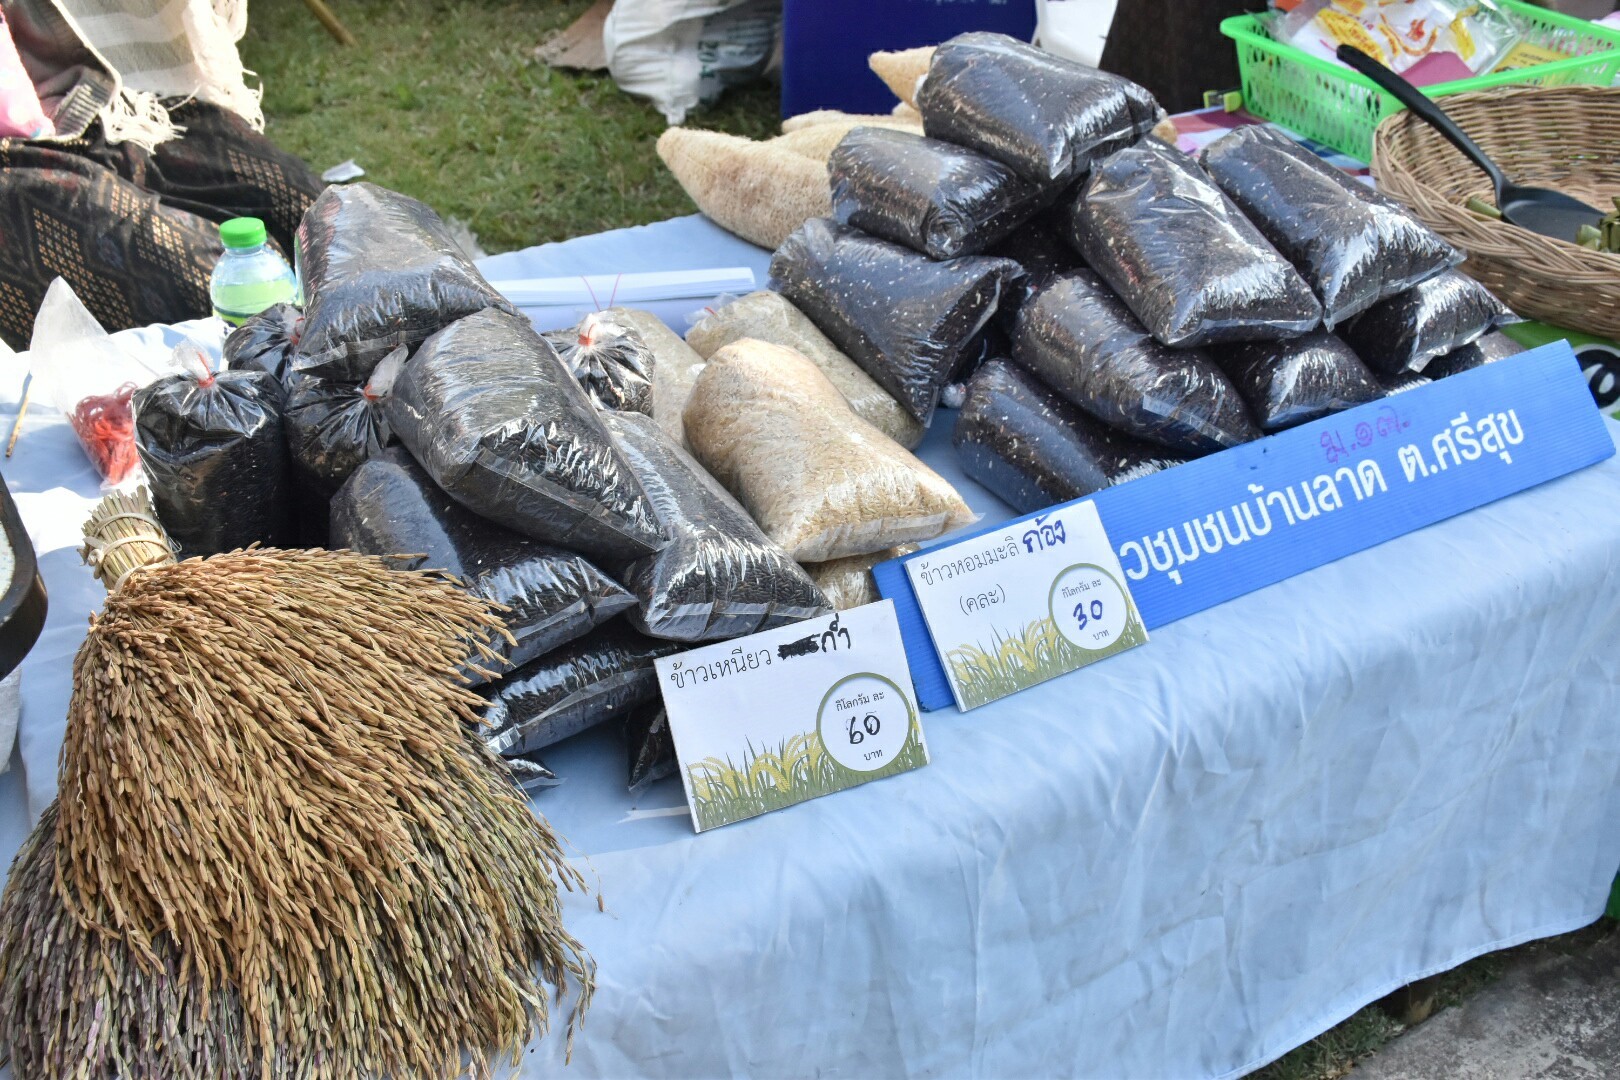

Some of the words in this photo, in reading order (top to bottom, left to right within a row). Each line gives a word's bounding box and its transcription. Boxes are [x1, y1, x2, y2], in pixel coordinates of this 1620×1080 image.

[1397, 408, 1524, 483] ต.ศรีสุข
[920, 535, 1020, 586] ข้าวหอมมะลิ
[959, 583, 1006, 617] (คละ)
[1072, 599, 1103, 631] 30
[1093, 629, 1110, 641] บาท
[670, 645, 772, 689] ข้าวเหนียว
[848, 714, 881, 745] 60
[864, 749, 883, 761] บาท
